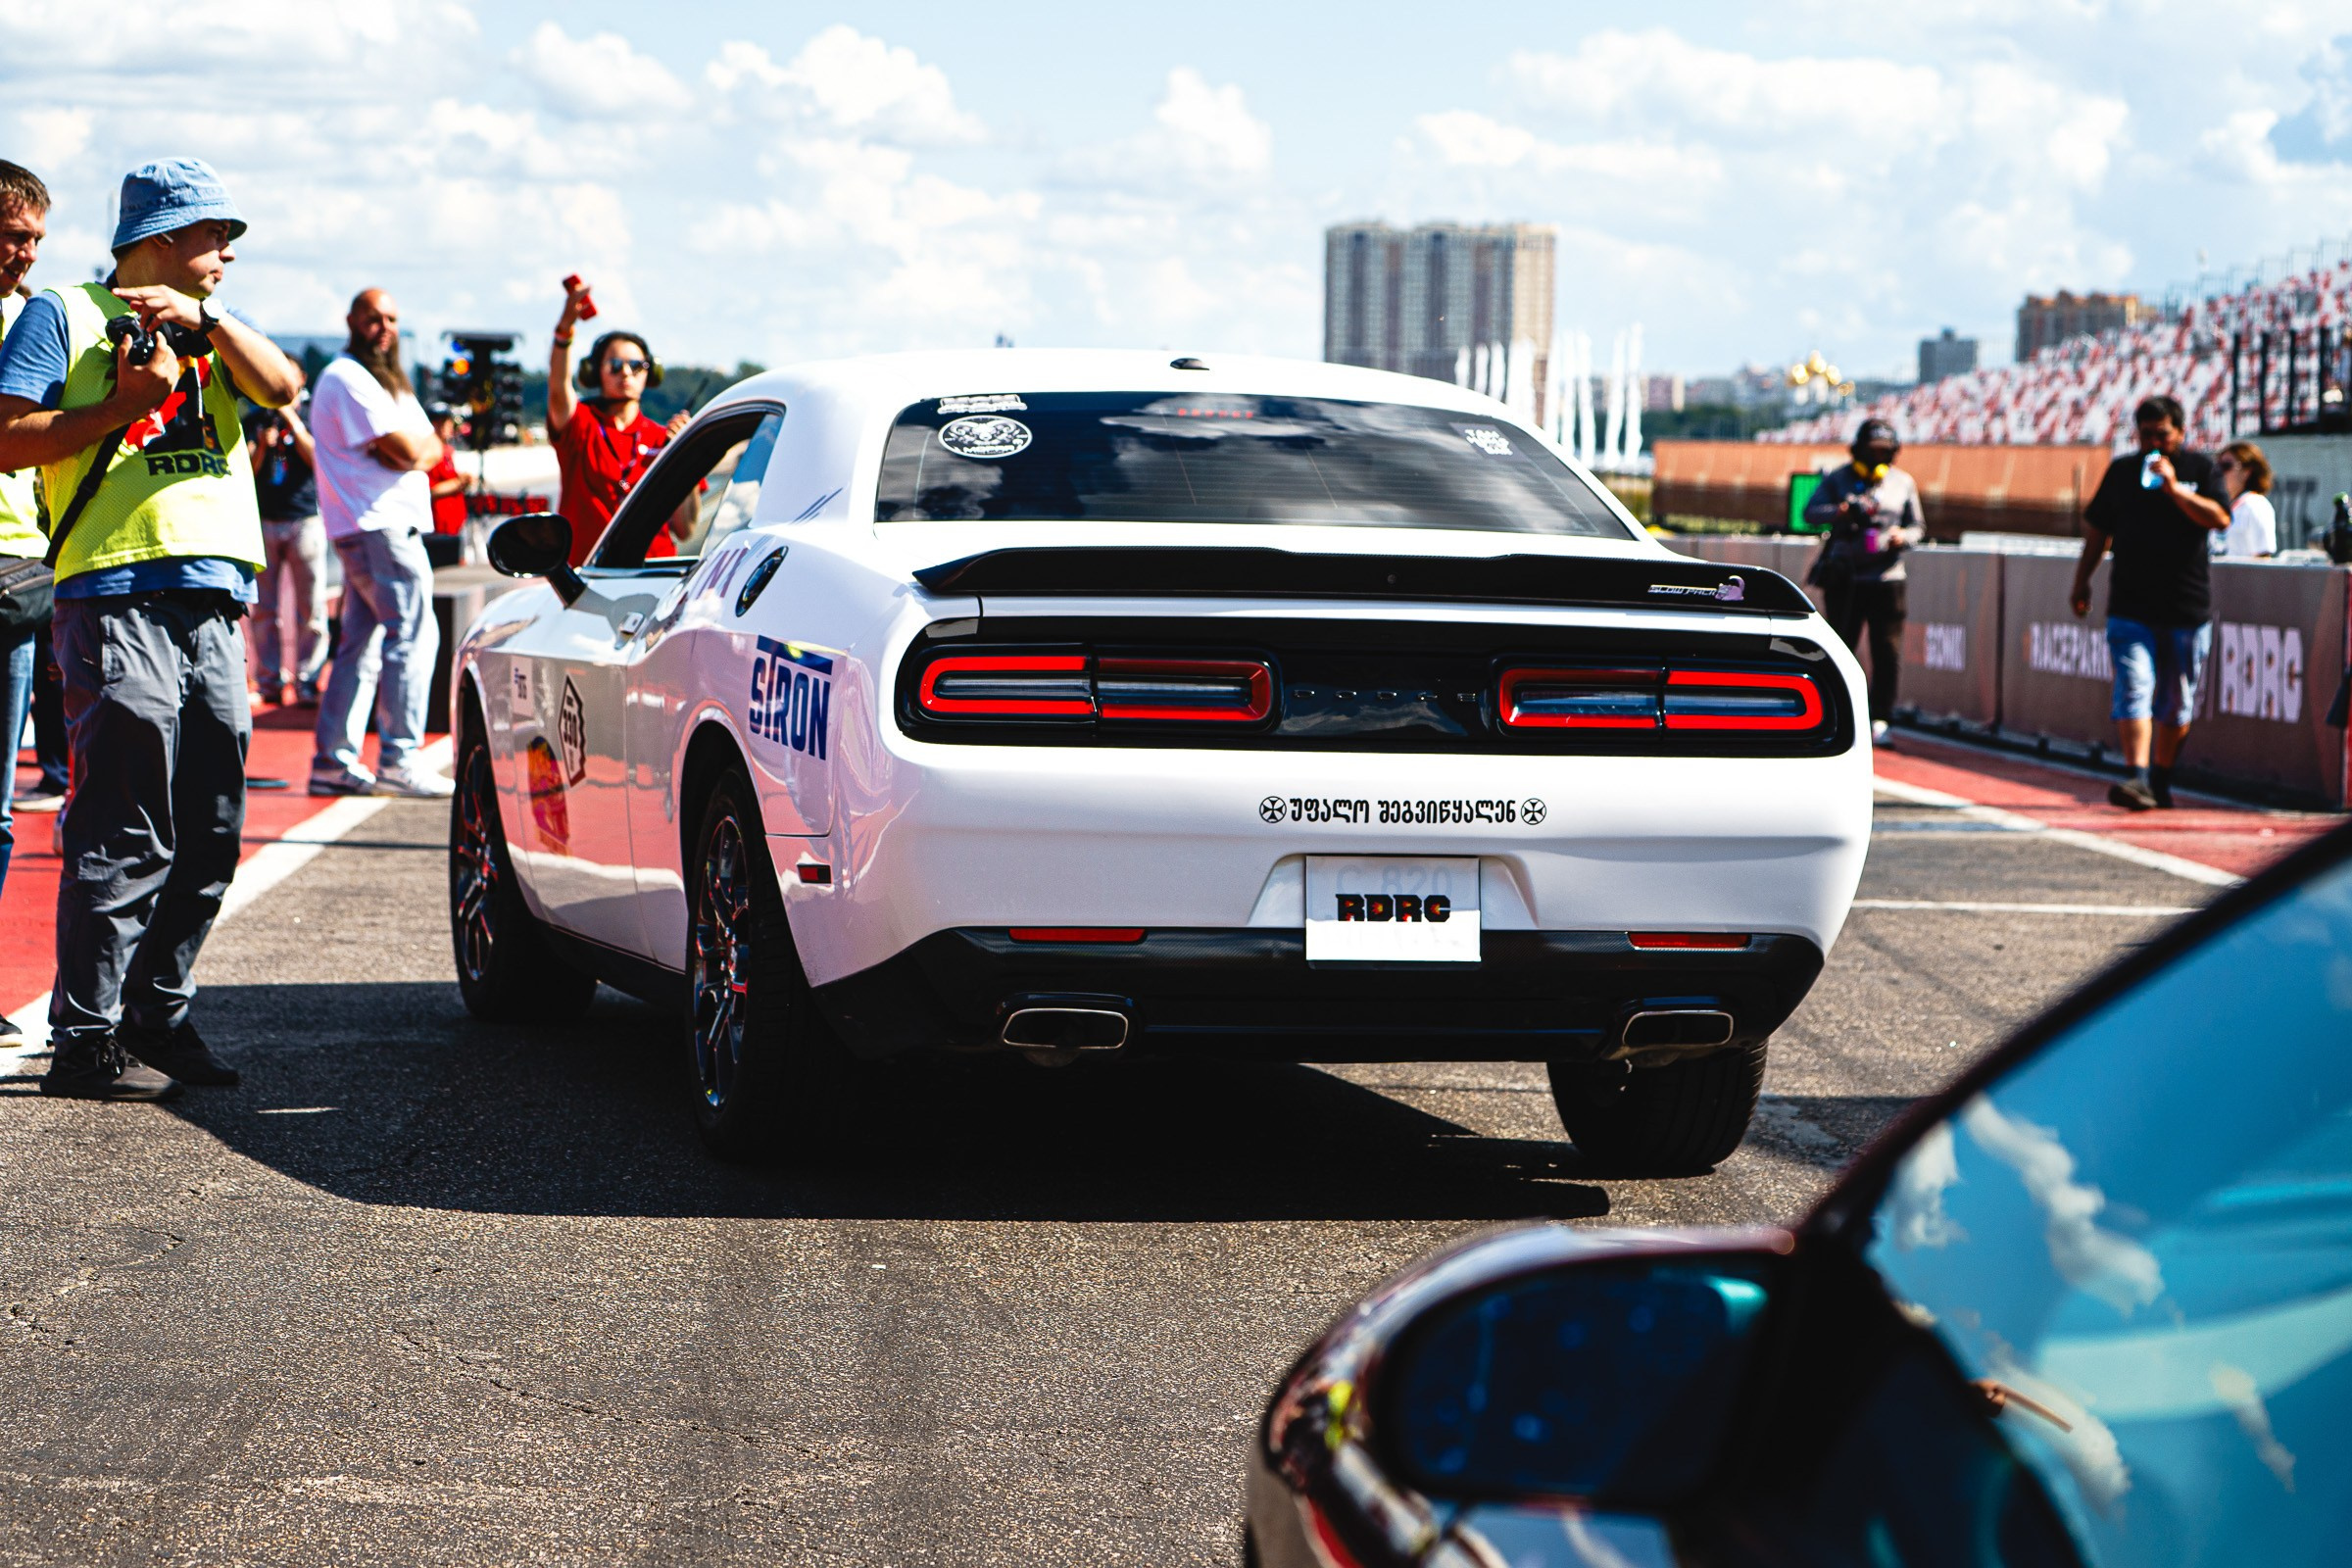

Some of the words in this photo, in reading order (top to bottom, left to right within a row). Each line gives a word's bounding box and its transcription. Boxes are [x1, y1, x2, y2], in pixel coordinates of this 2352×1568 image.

[2220, 622, 2303, 724] RDRC
[1290, 797, 1370, 824] უფალო
[1377, 799, 1516, 824] შეგვიწყალენ
[1335, 893, 1451, 923] RDRC
